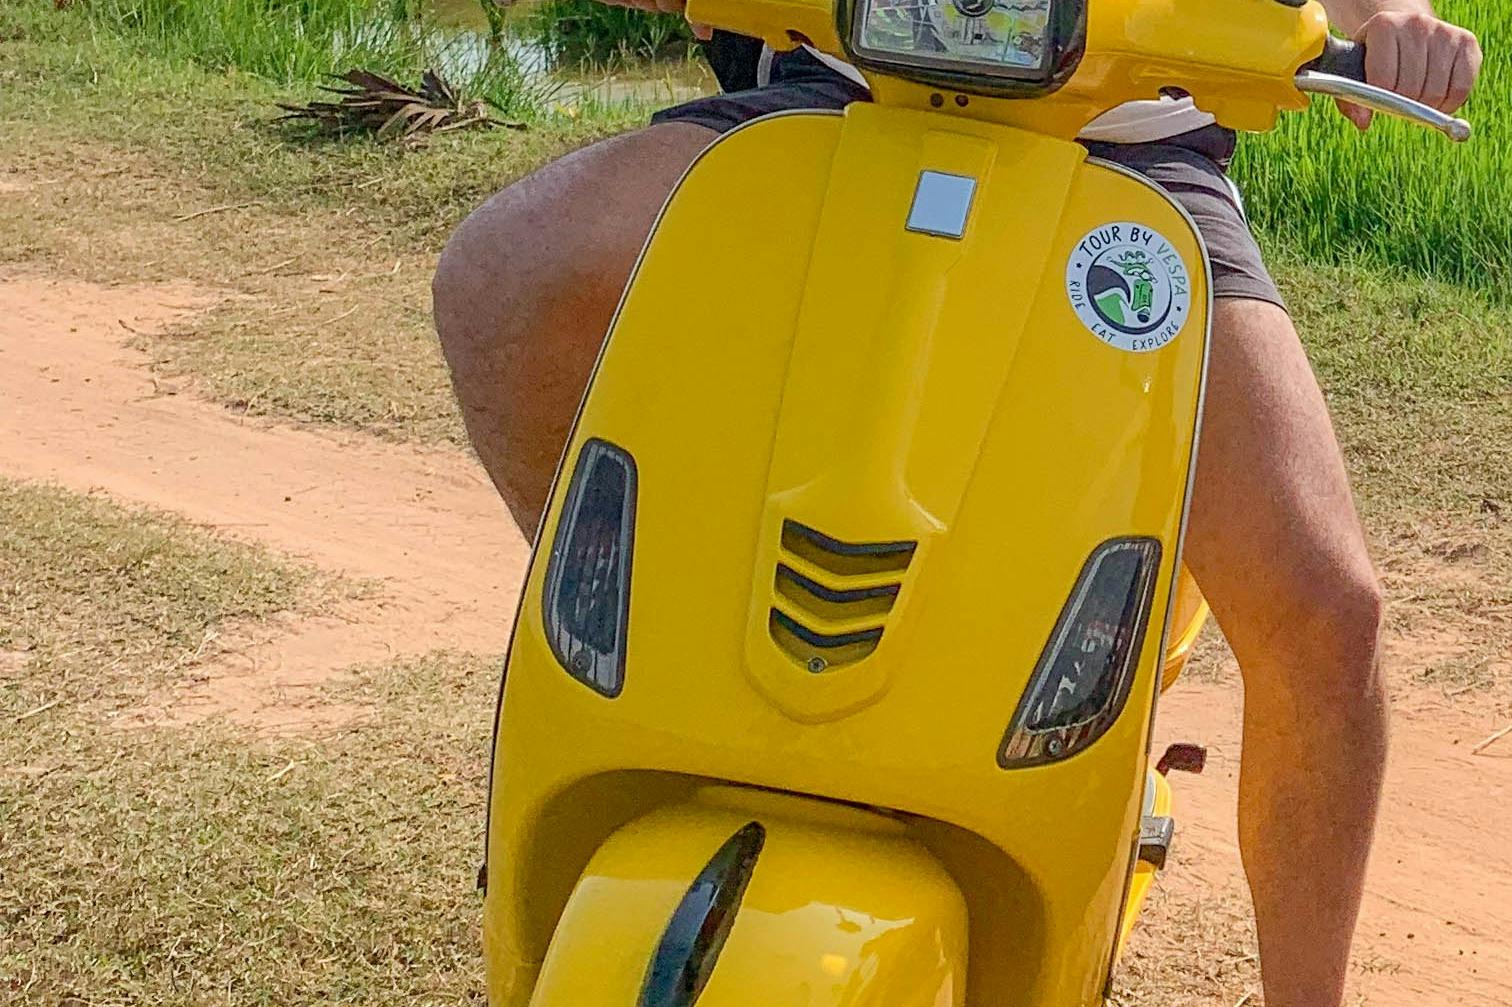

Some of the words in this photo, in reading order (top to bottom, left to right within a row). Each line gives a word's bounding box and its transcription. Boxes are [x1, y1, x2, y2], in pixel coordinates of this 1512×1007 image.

[1079, 226, 1122, 257] TOUR
[1130, 227, 1152, 245] BY
[1156, 242, 1187, 296] VESPA
[1069, 280, 1085, 309] RIDE
[1091, 323, 1116, 342] EAT
[1132, 321, 1179, 350] EXPLORE
